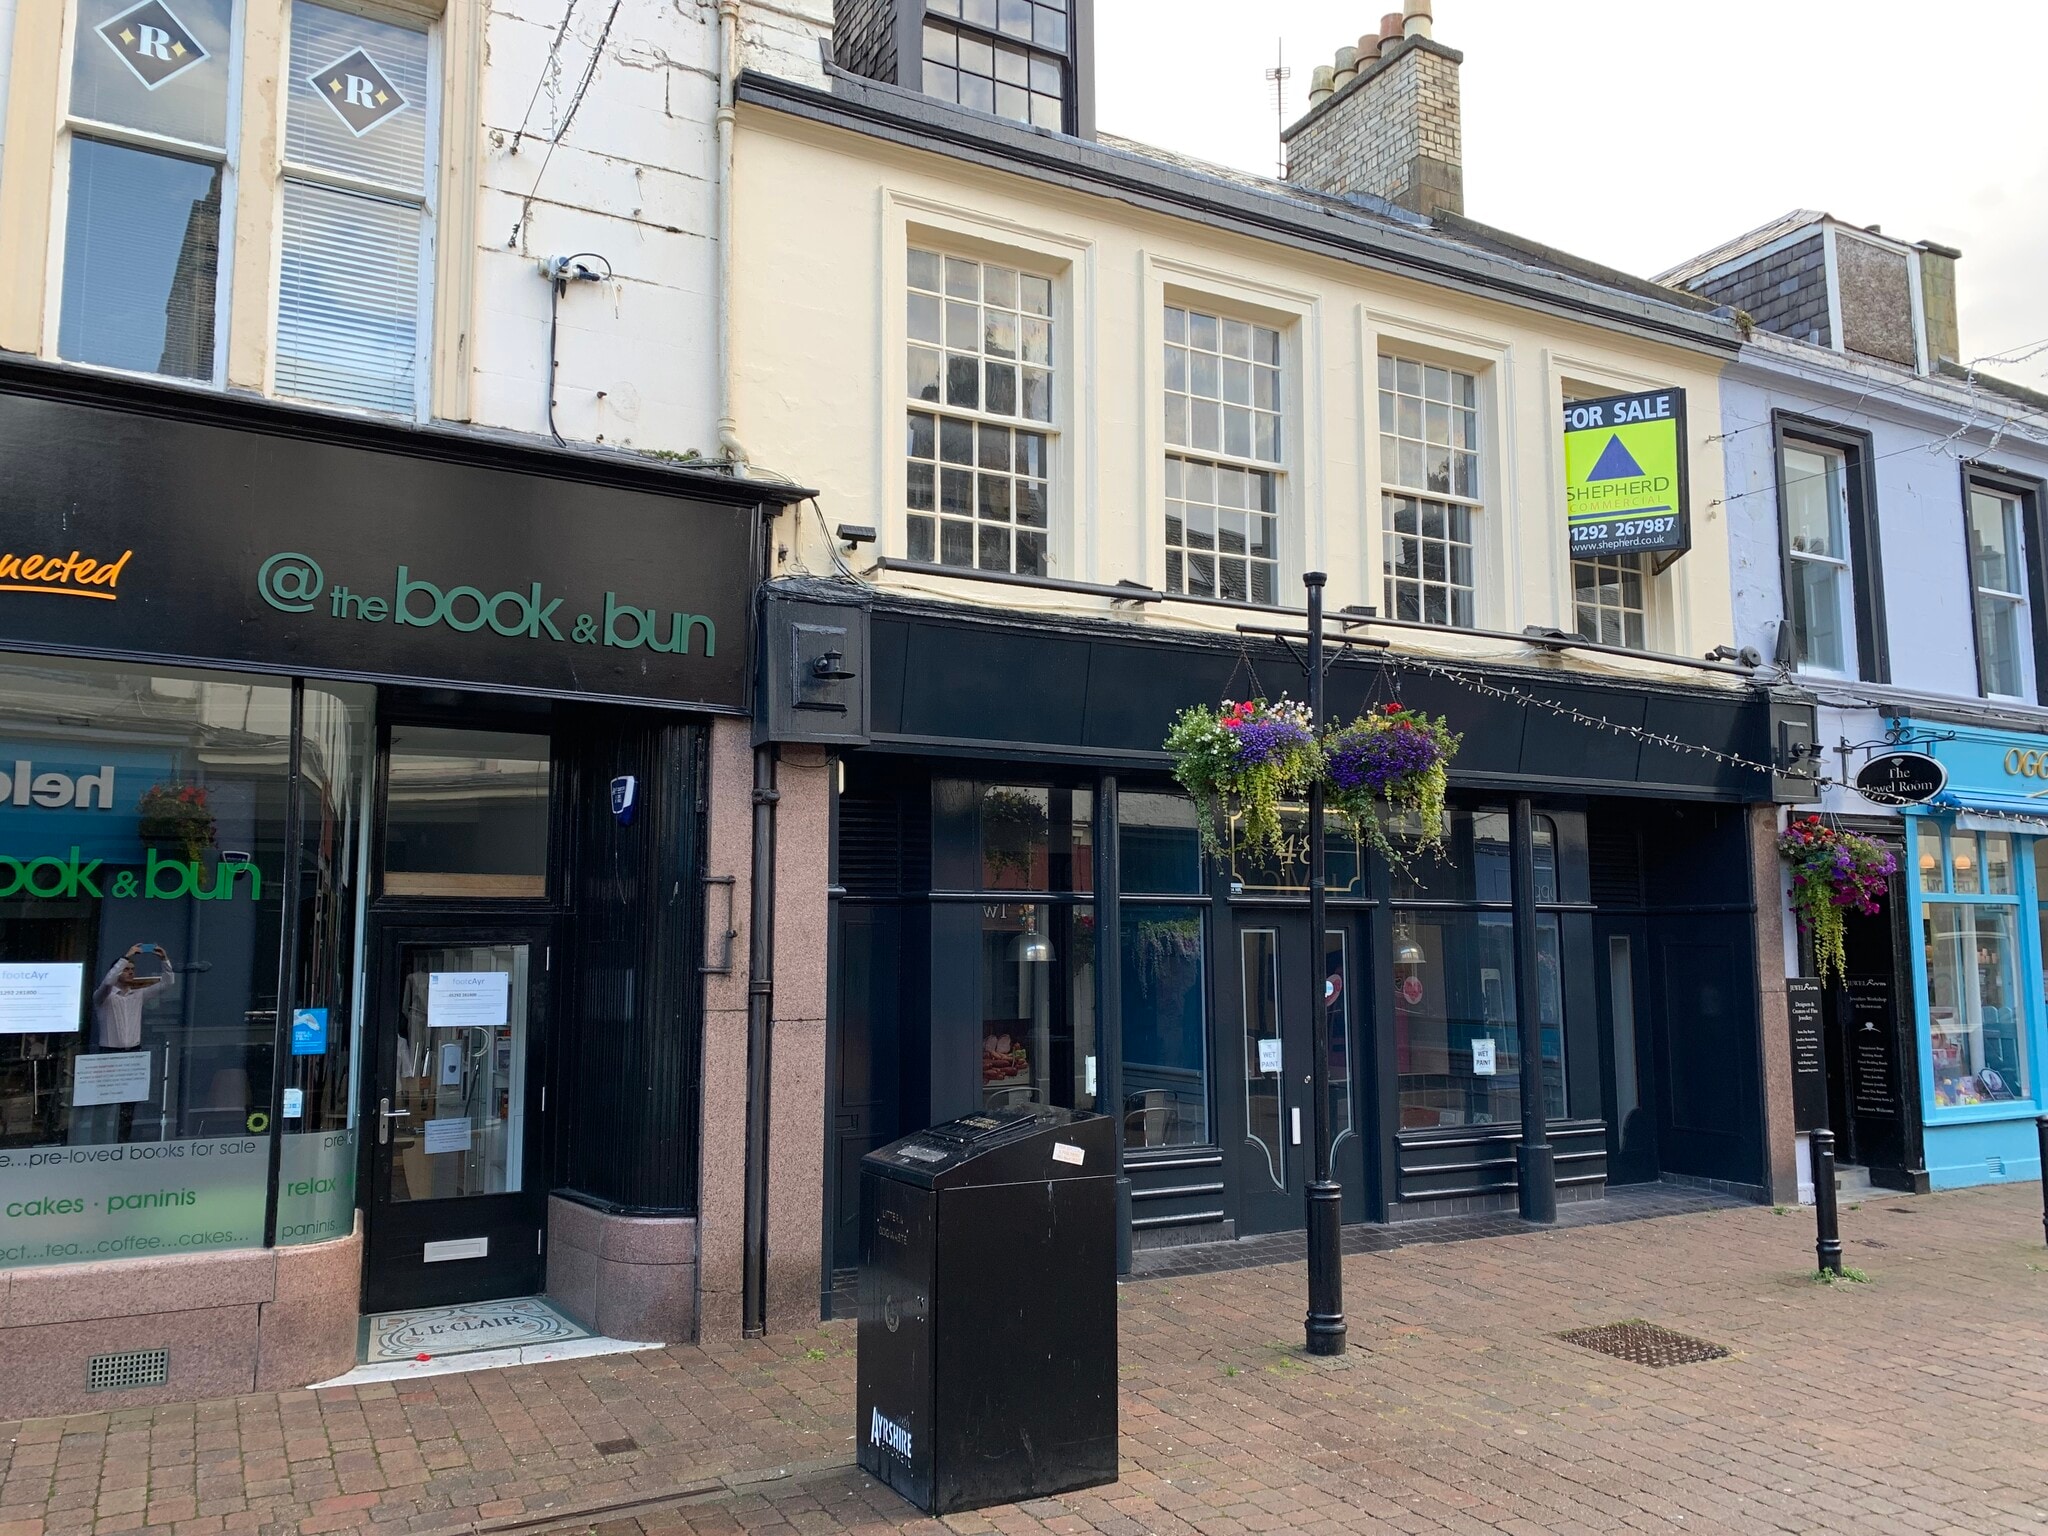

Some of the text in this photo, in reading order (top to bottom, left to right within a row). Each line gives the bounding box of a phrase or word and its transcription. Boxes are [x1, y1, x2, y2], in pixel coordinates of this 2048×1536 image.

[135, 23, 172, 62] R
[343, 73, 376, 110] R
[1563, 395, 1670, 431] FOR SALE
[1567, 476, 1670, 502] SHEPHERD
[1569, 495, 1664, 513] COMMERCIAL
[1569, 517, 1675, 542] 1292 267987
[1571, 534, 1665, 552] www.shepherd.co.uk
[256, 552, 717, 657] @ the book & bun
[1888, 766, 1911, 779] The
[1898, 781, 1934, 792] Room
[111, 870, 139, 898] &
[144, 848, 261, 901] bun
[129, 1143, 185, 1160] books
[191, 1142, 219, 1157] for
[219, 1140, 256, 1155] sale
[287, 1176, 336, 1197] relax
[6, 1188, 197, 1217] cakes paninis
[448, 1315, 527, 1332] CLAIR
[870, 1406, 912, 1459] AYRSHIRE
